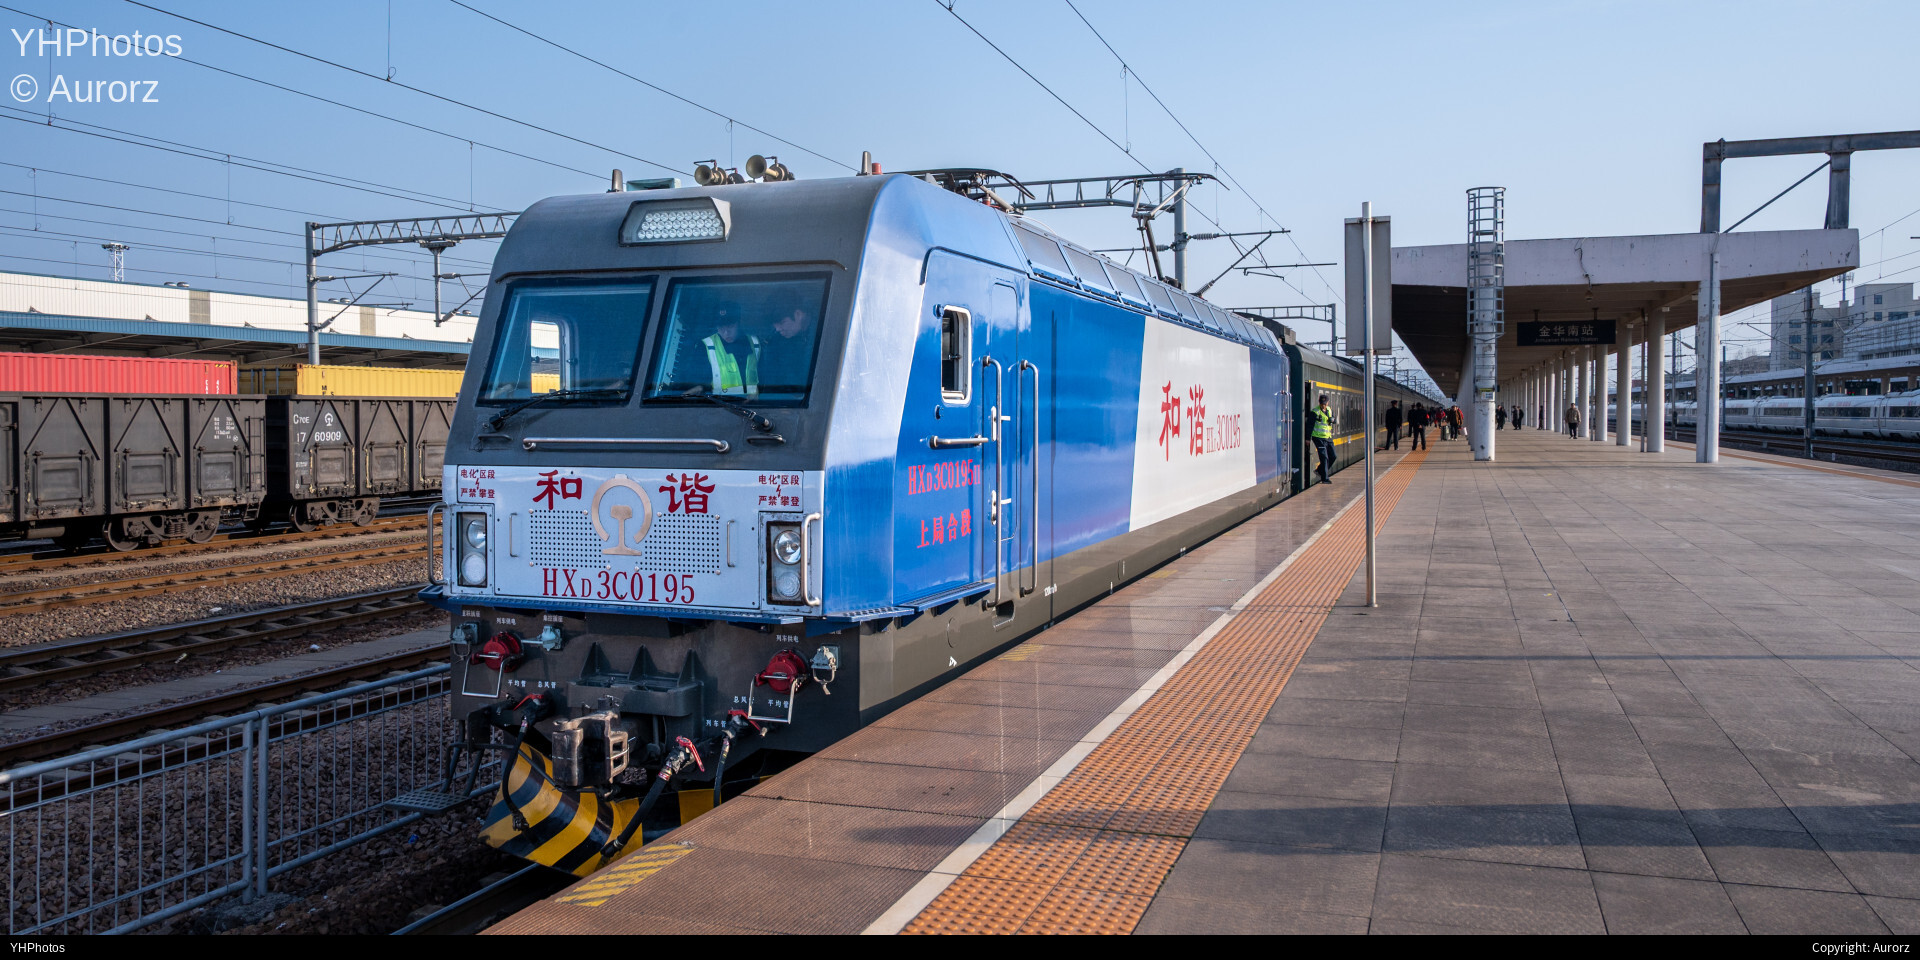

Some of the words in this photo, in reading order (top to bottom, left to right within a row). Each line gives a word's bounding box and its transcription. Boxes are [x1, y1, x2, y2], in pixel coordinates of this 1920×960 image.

[1539, 324, 1594, 337] 金华南站
[1159, 380, 1206, 462] 和谐
[296, 432, 307, 443] 17
[314, 431, 342, 442] 60909
[460, 469, 496, 479] 电化区段
[758, 474, 800, 486] 电化区段
[460, 487, 496, 499] 严禁攀登
[758, 495, 800, 507] 严禁攀登
[916, 508, 972, 548] 上局合段
